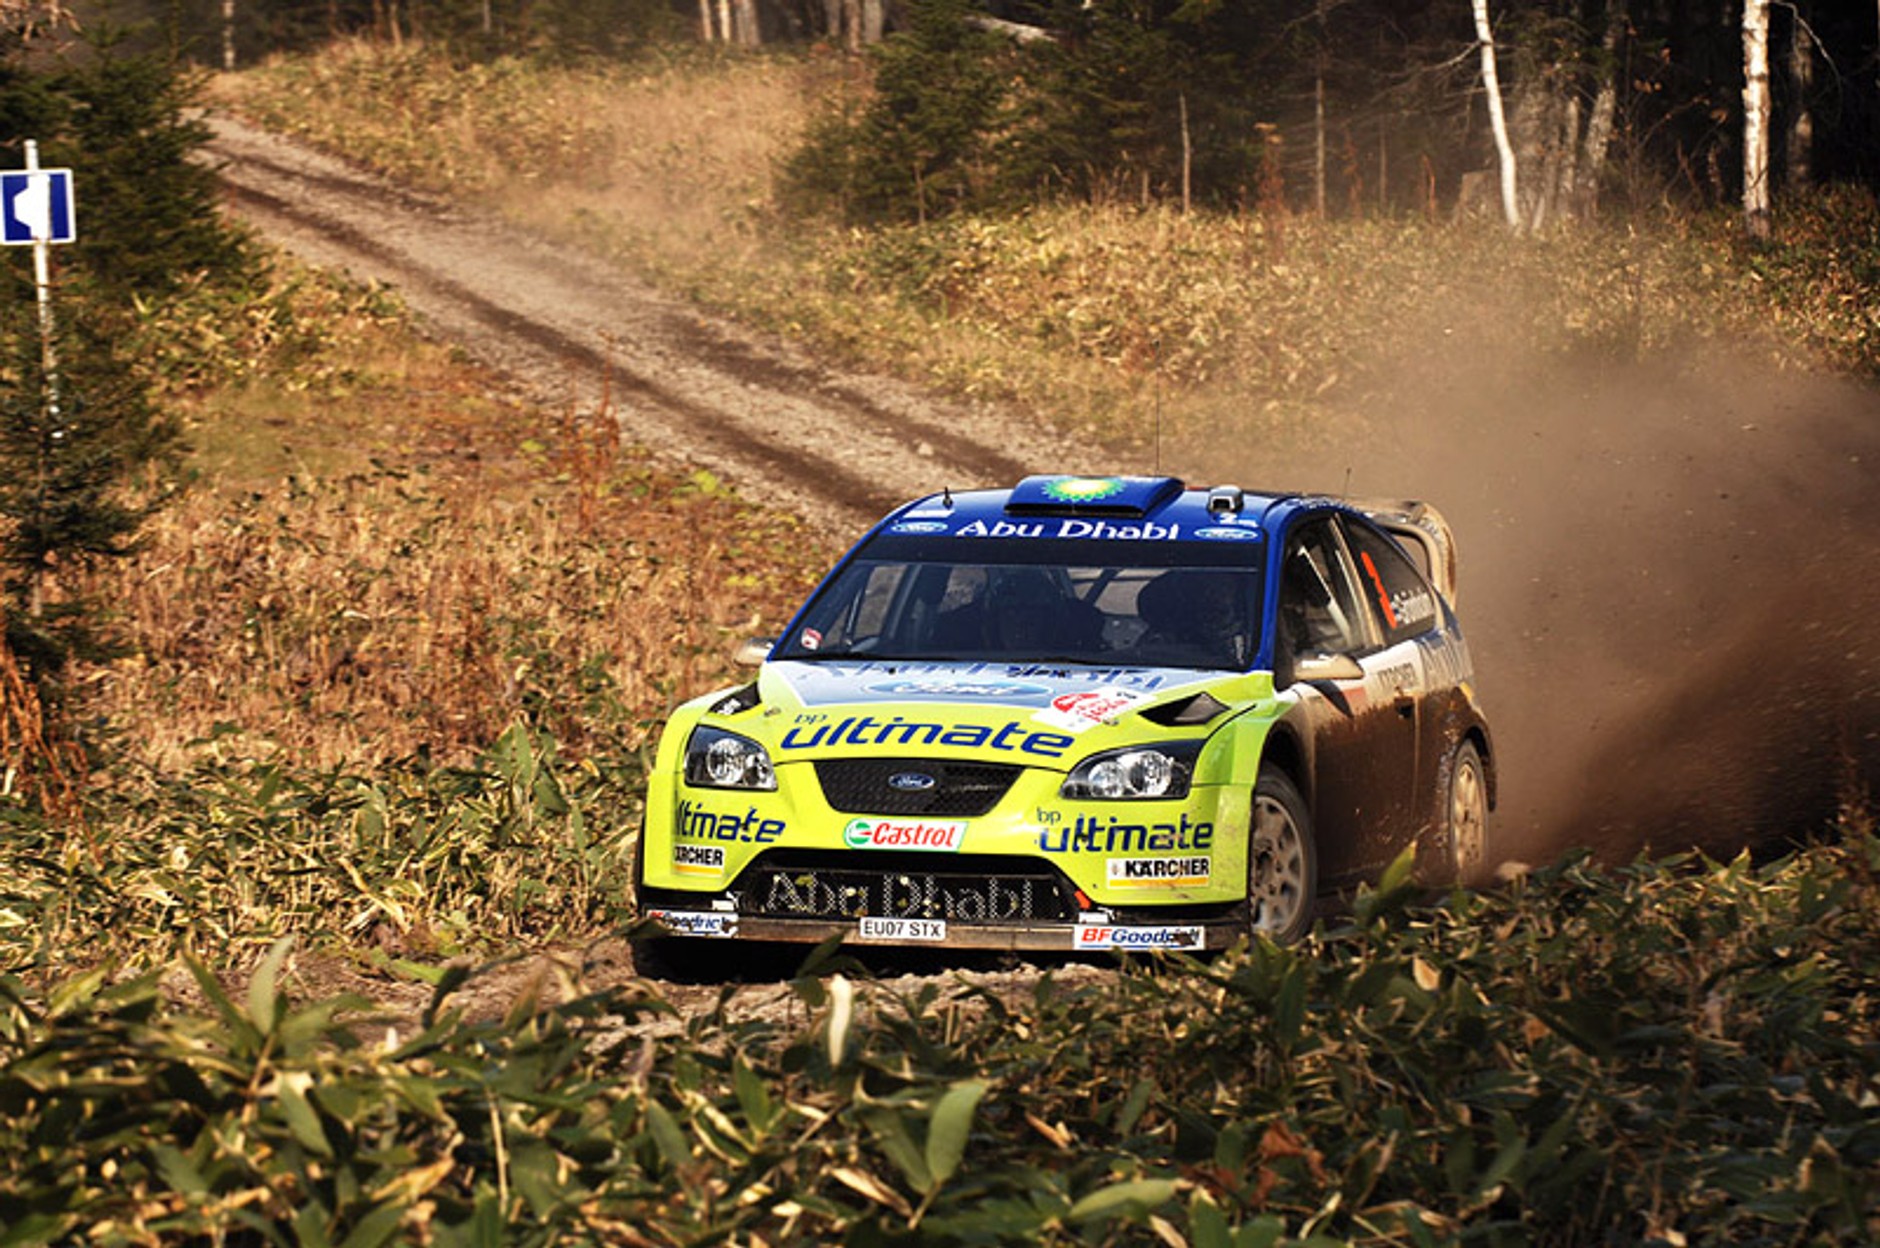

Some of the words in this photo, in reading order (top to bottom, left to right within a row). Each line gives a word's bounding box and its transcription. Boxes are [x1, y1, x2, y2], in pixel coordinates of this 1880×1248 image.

[956, 519, 1045, 537] Abu
[1057, 519, 1180, 540] Dhabi
[794, 713, 828, 725] bp
[780, 715, 1075, 758] ultimate
[1037, 806, 1062, 825] bp
[873, 821, 955, 847] Castrol
[1039, 812, 1214, 853] ultimate
[1125, 857, 1210, 877] KÄRCHER
[883, 873, 1033, 920] Dhabi
[864, 918, 904, 936] EU07
[909, 919, 942, 938] STX
